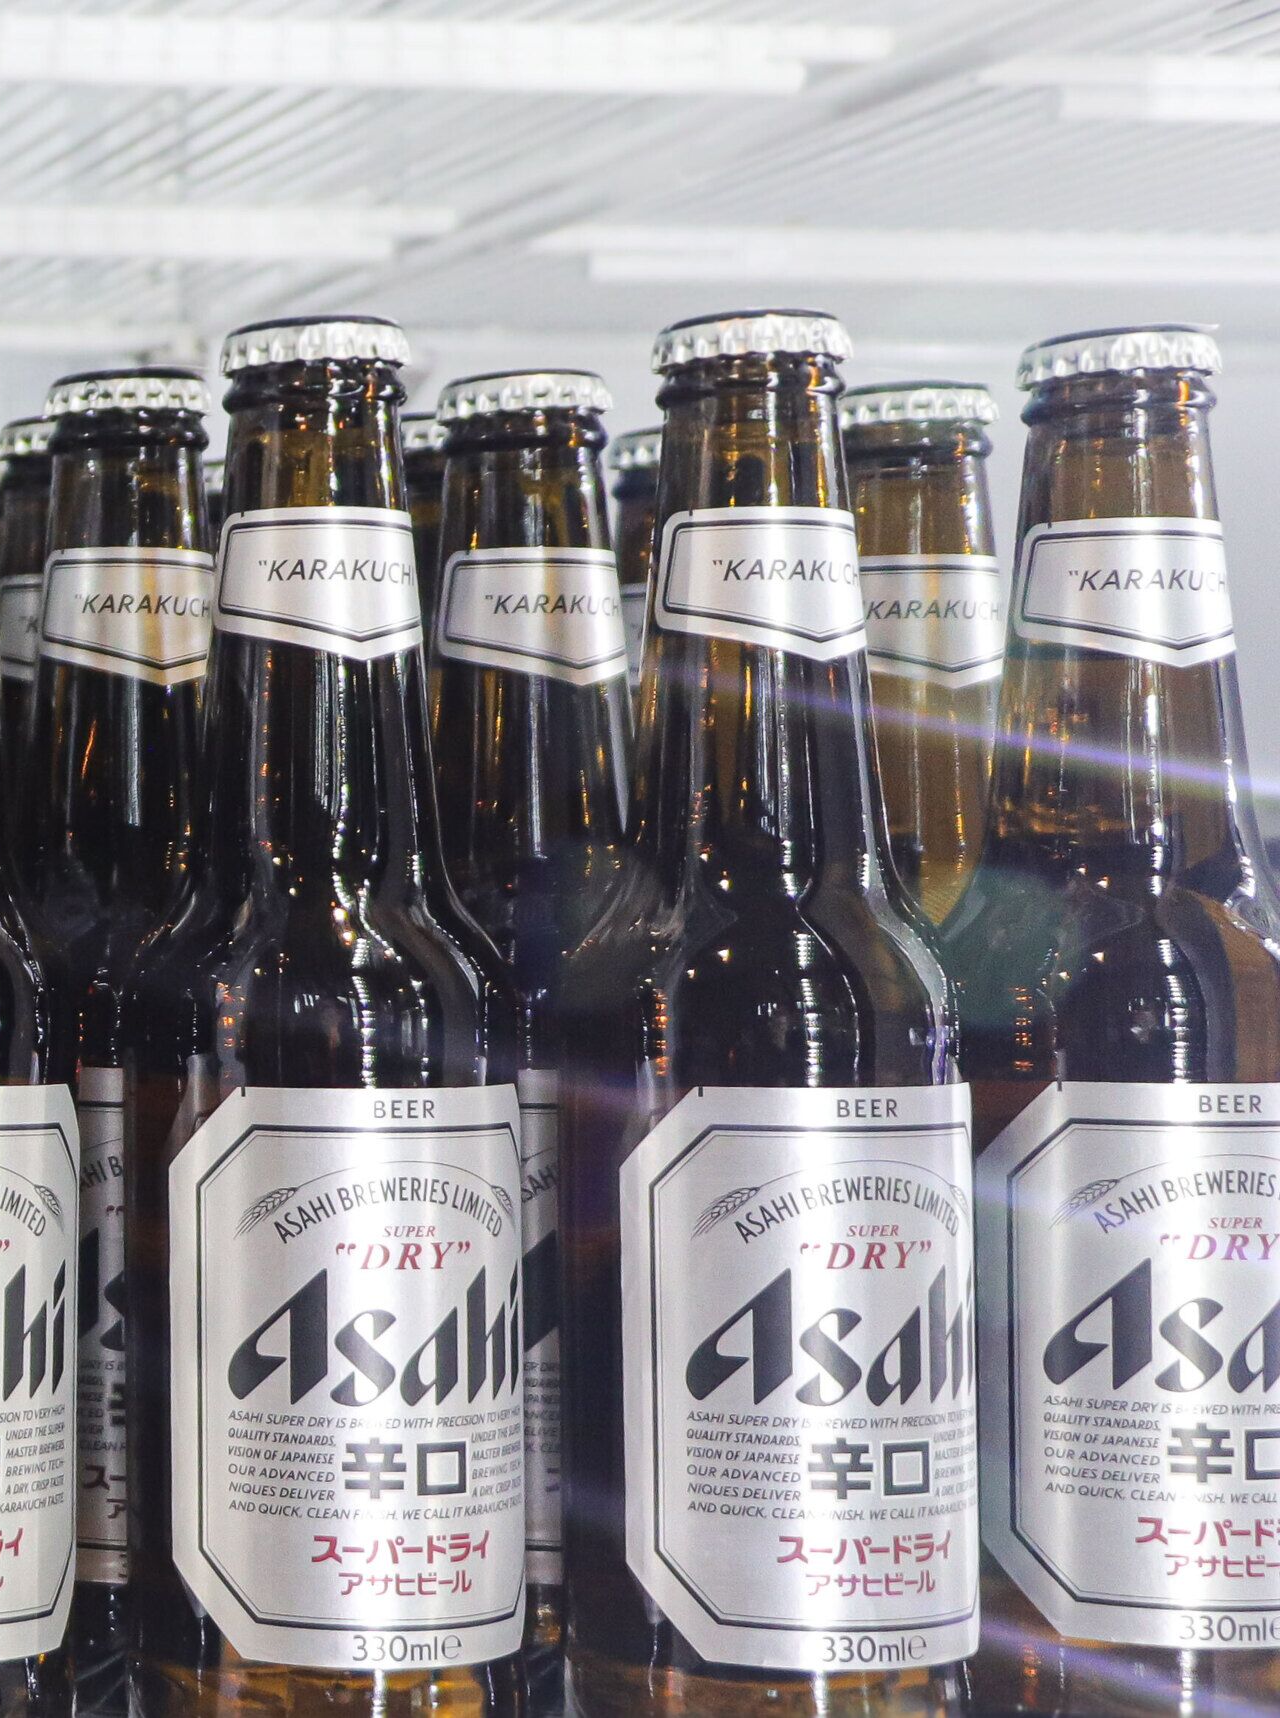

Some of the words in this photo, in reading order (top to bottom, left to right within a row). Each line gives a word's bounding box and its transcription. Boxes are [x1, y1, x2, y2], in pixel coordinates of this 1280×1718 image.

[374, 1099, 436, 1119] BEER
[837, 1098, 898, 1118] BEER
[1199, 1094, 1262, 1113] BEER
[273, 1193, 337, 1244] ASAHI
[341, 1176, 449, 1210] BREWERIES
[451, 1184, 502, 1238] LIMITED
[734, 1191, 800, 1243] ASAHI
[804, 1176, 912, 1211] BREWERIES
[914, 1183, 959, 1237] LIMITED
[1093, 1184, 1161, 1234] ASAHI
[1161, 1170, 1277, 1202] BREWERIES
[382, 1225, 435, 1238] SUPER
[846, 1224, 899, 1238] SUPER
[1208, 1217, 1262, 1229] SUPER
[1160, 1233, 1280, 1261] "DRY
[228, 1259, 519, 1406] Asahi
[1042, 1257, 1280, 1394] Asa
[341, 1437, 467, 1500] 辛口
[807, 1437, 930, 1500] 辛口
[1135, 1516, 1280, 1547] スーパード
[311, 1530, 490, 1564] スーパードライ
[776, 1530, 951, 1564] スーパードライ
[1165, 1553, 1280, 1578] アサヒビー
[338, 1570, 472, 1596] アサヒビール
[805, 1570, 936, 1597] アサヒビール
